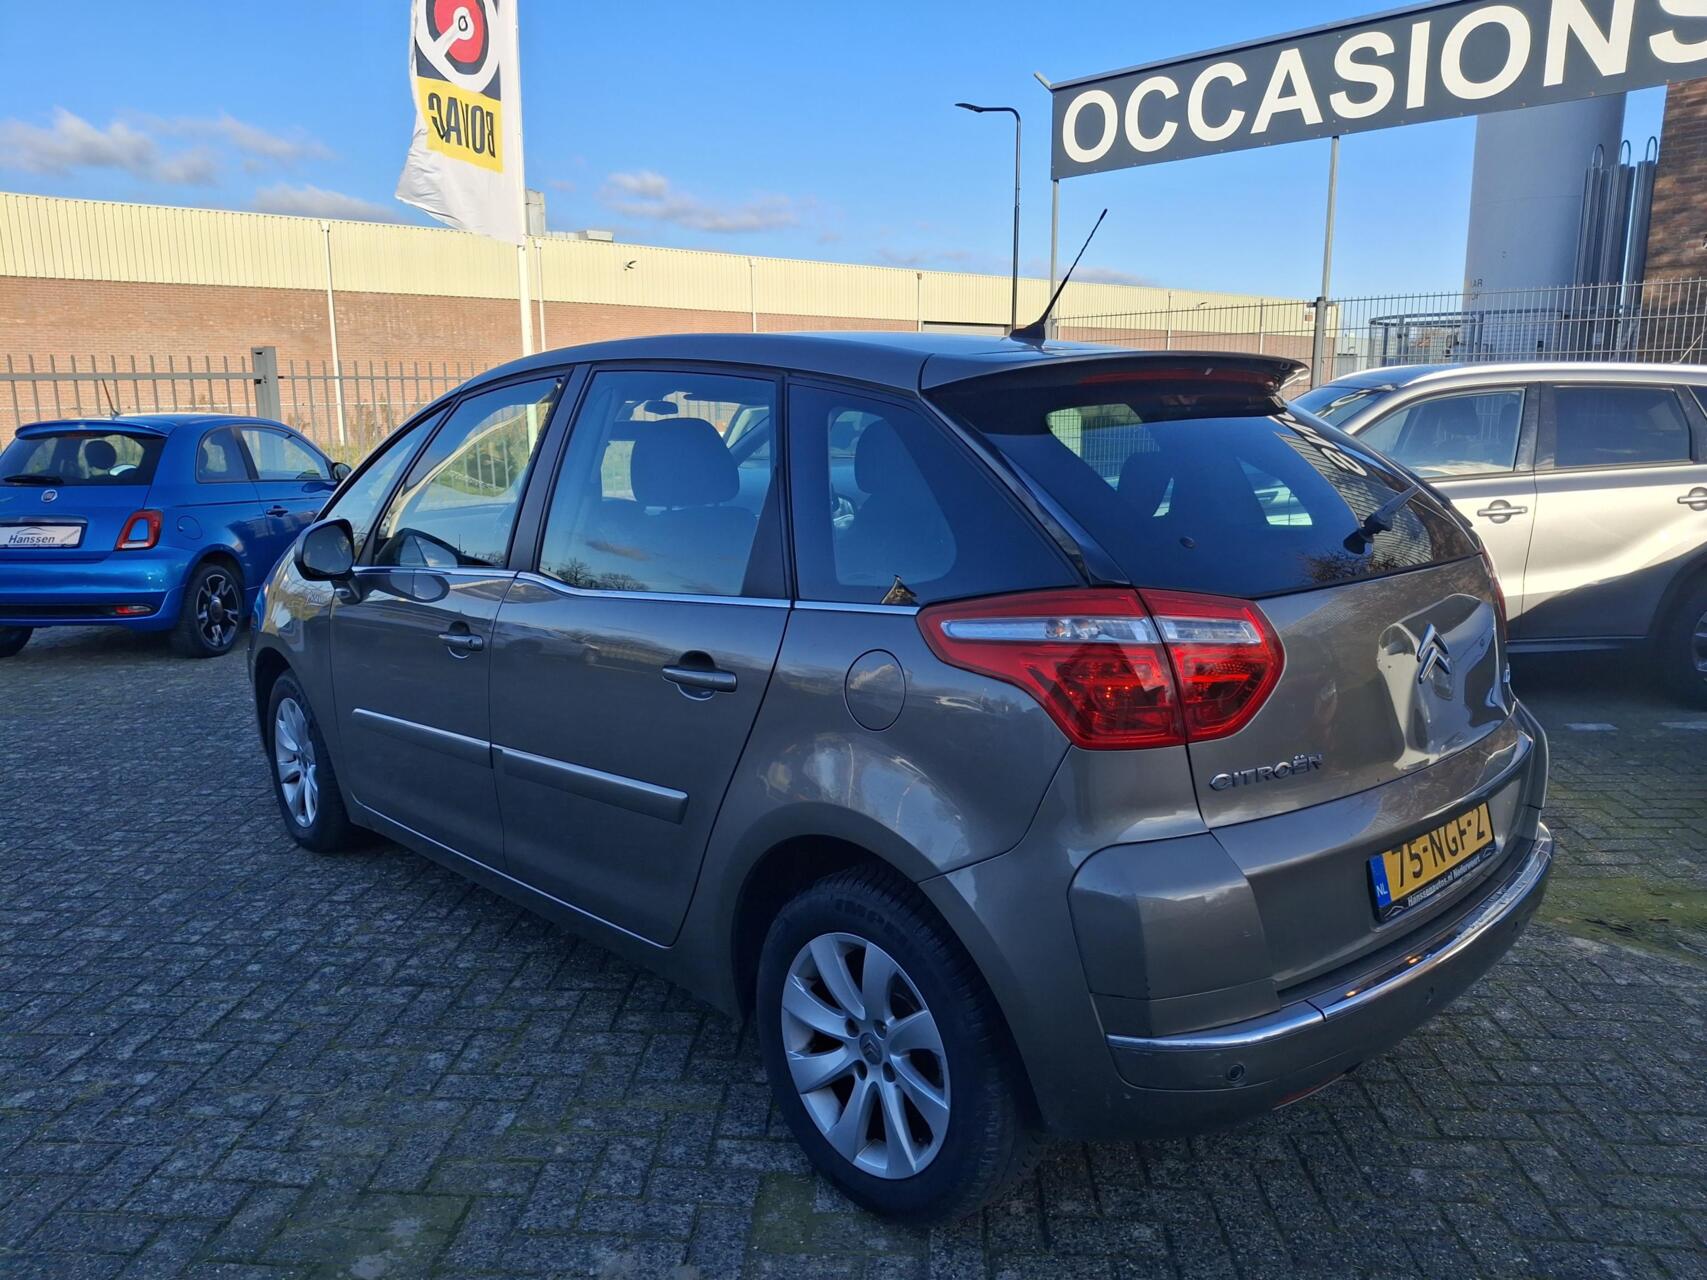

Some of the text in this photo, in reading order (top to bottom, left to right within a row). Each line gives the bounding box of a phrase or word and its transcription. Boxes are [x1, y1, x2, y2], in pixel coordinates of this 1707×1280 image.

[8, 534, 56, 544] Hanssen
[1209, 753, 1322, 791] CITROËN
[1376, 885, 1388, 898] NL
